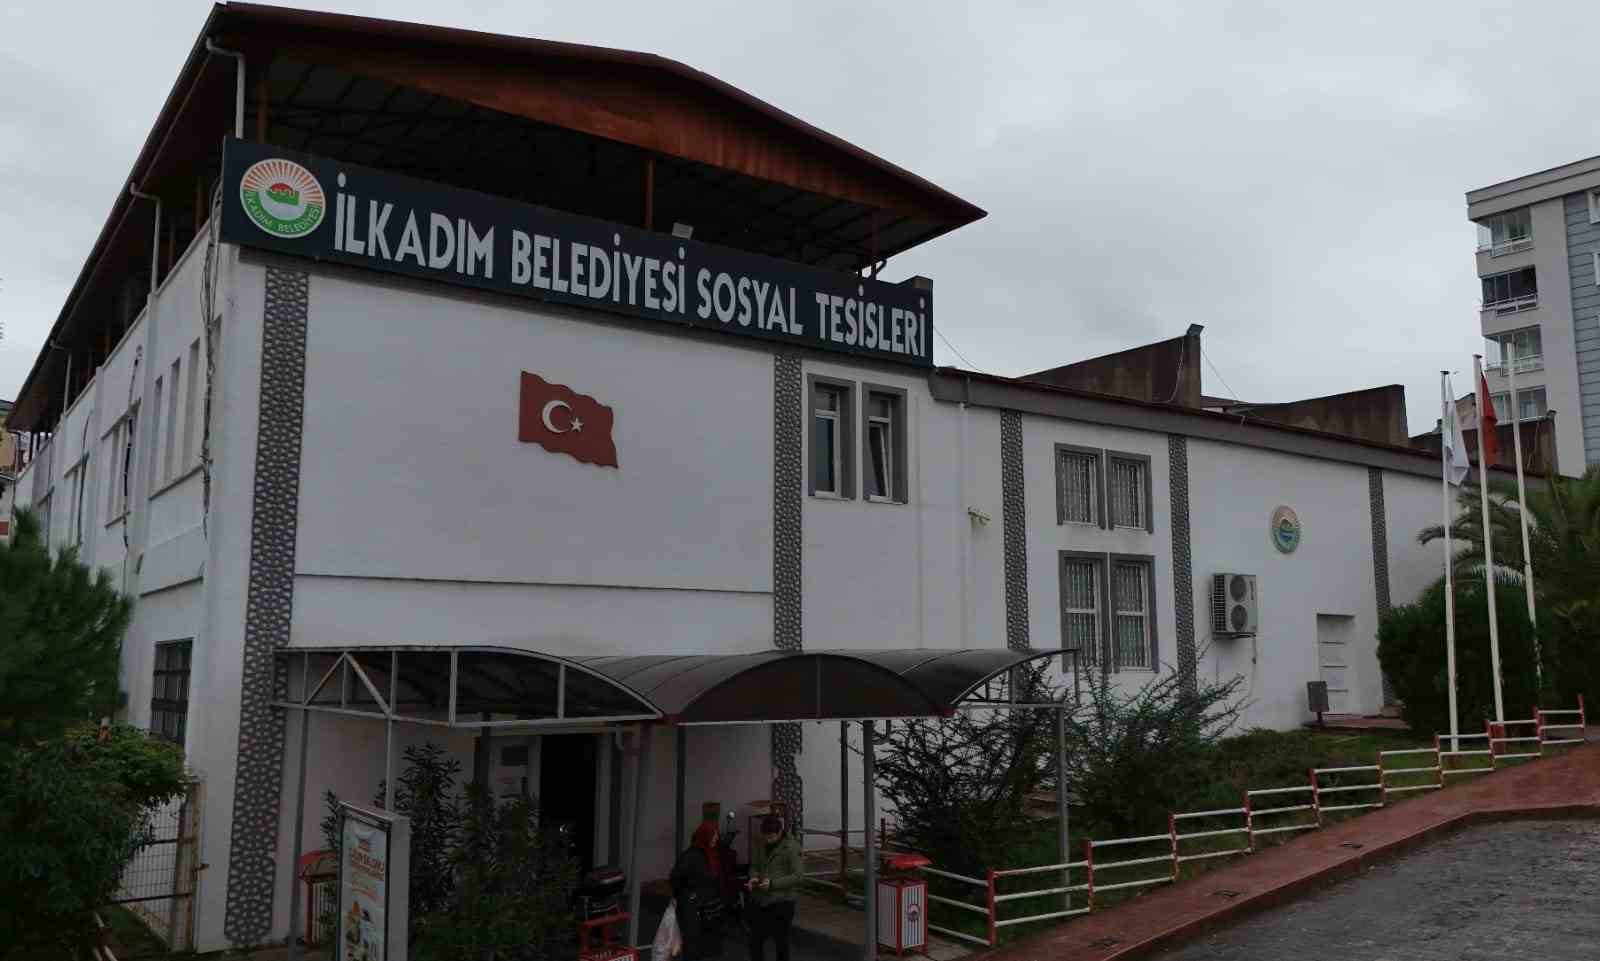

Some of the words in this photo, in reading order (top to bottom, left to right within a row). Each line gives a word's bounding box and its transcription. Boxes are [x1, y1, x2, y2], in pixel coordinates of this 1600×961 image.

[334, 172, 496, 279] İLKADIM
[511, 228, 687, 314] BELEDİYESİ
[696, 267, 805, 336] SOSYAL
[815, 285, 926, 357] TESİSLERİ
